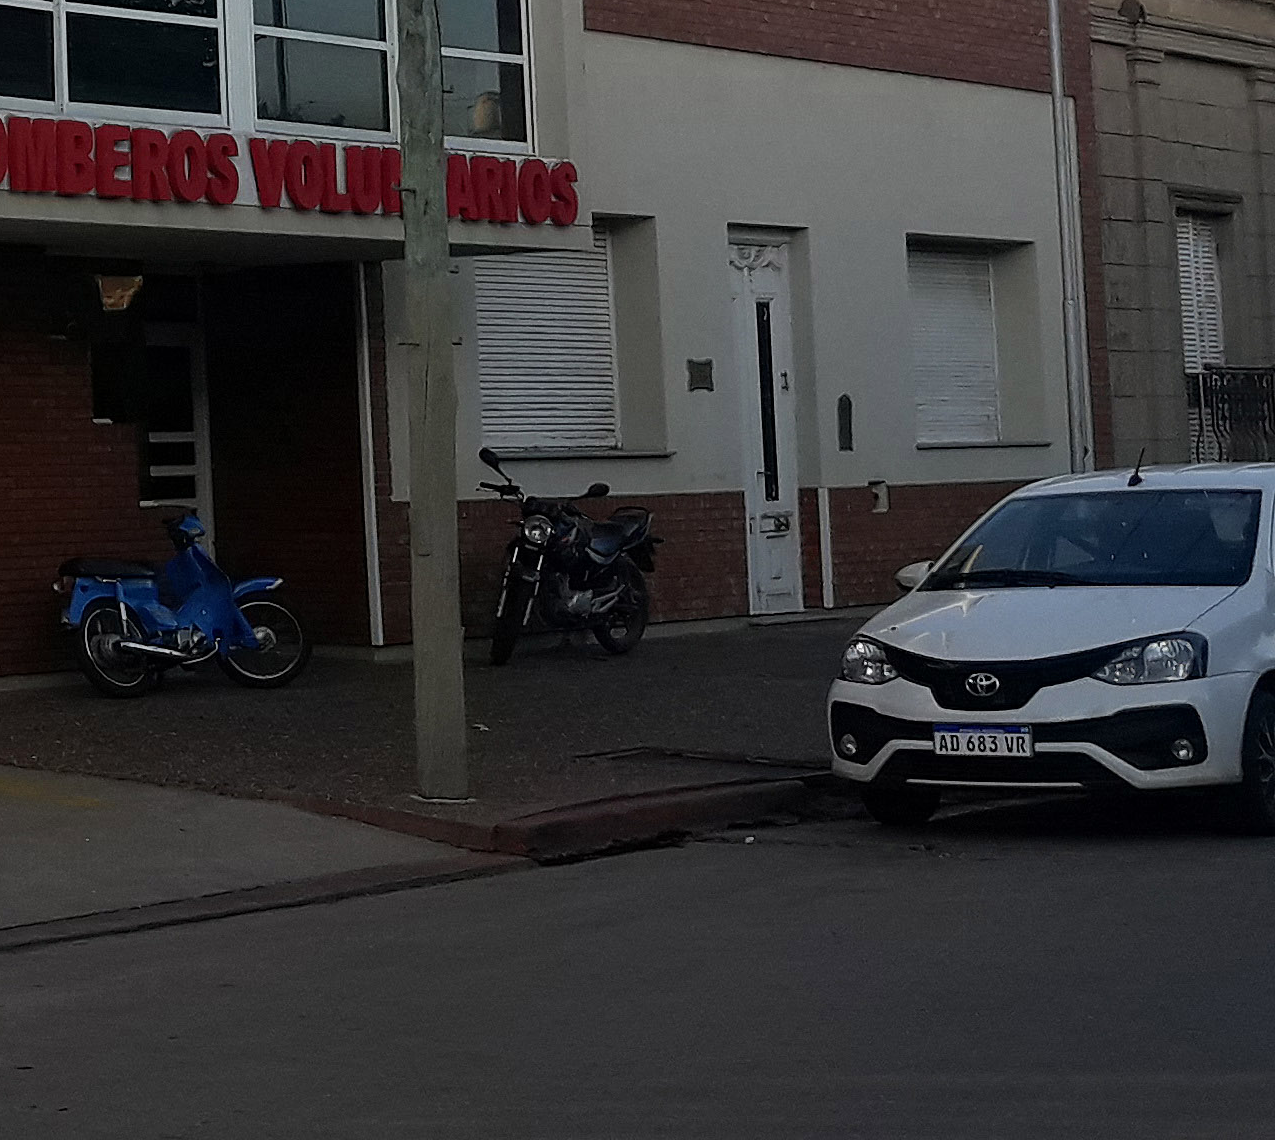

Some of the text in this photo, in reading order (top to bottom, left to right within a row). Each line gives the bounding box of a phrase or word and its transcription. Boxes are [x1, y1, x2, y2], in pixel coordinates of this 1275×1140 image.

[249, 138, 578, 225] VOLUARIOS
[939, 734, 1026, 753] AD 683 VR
